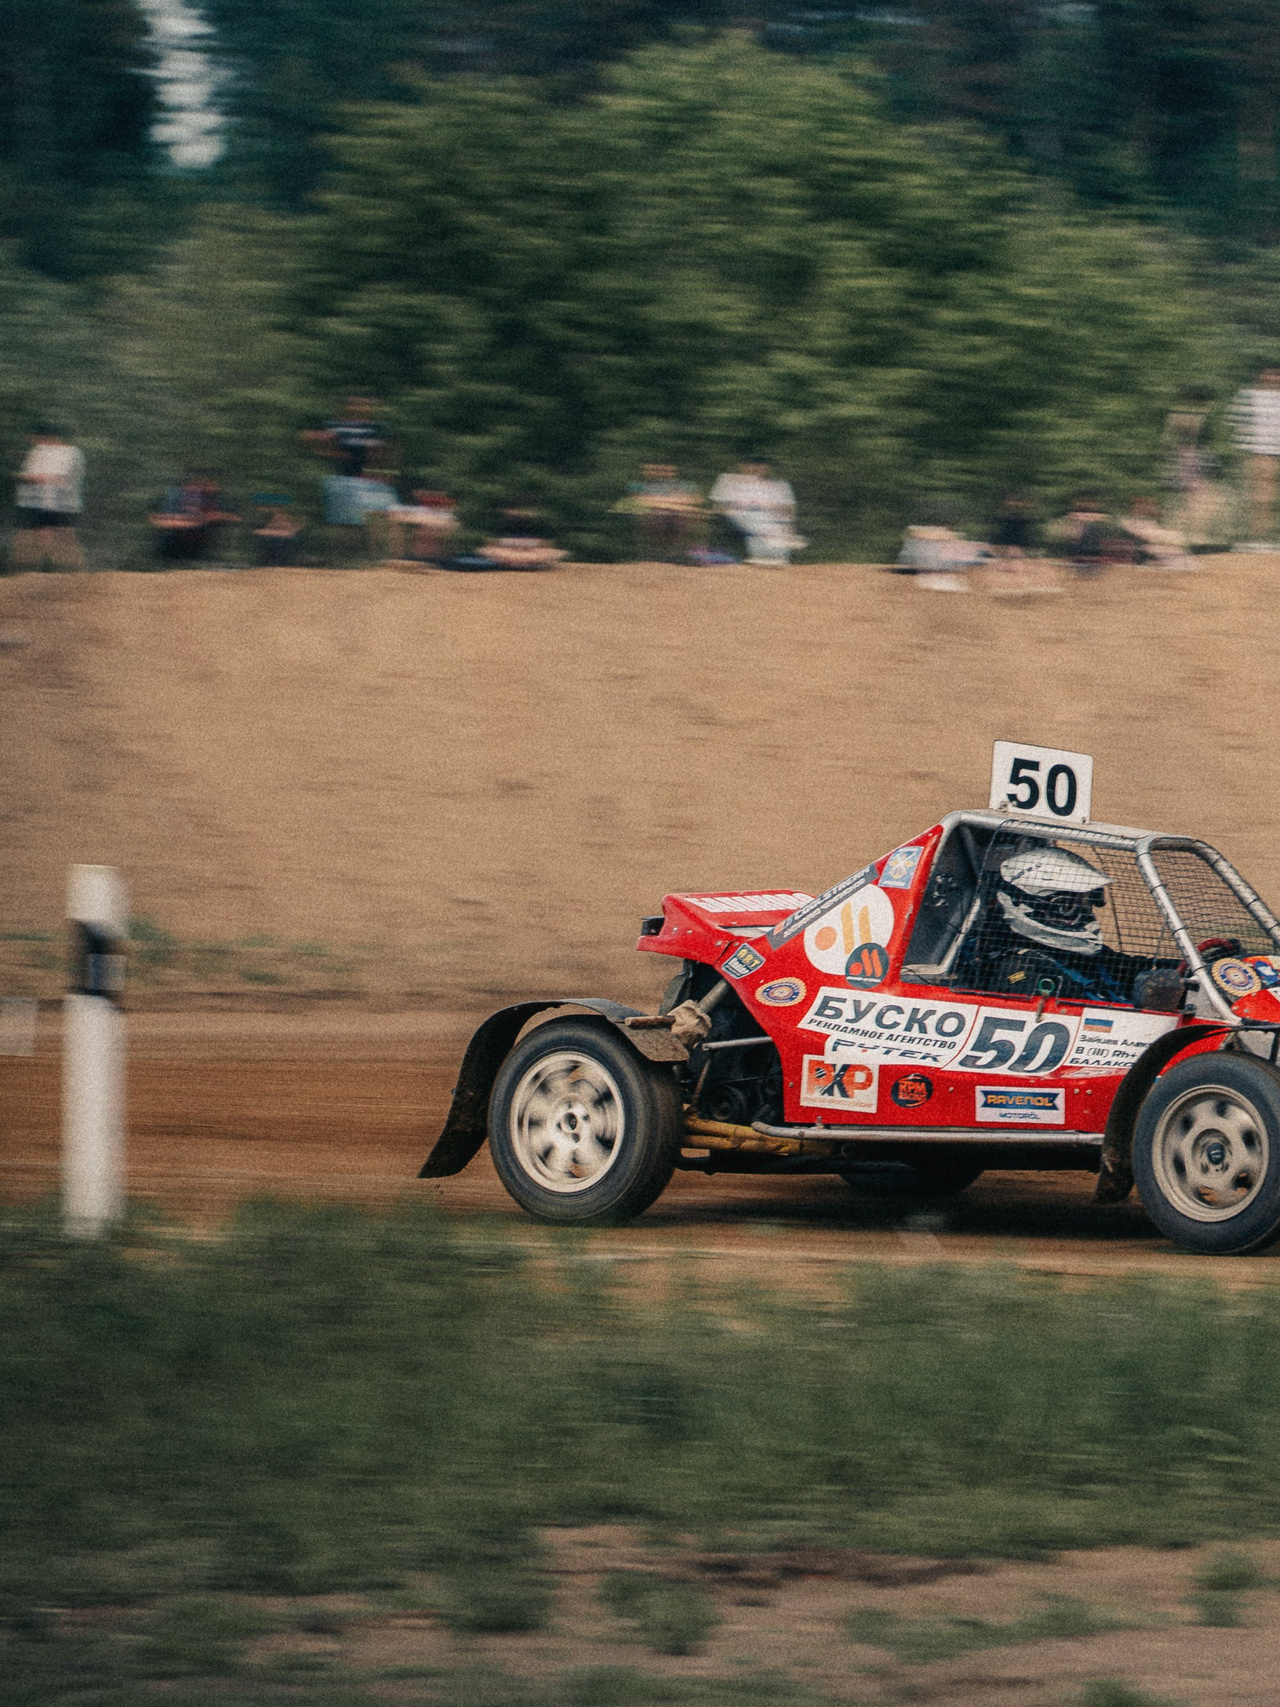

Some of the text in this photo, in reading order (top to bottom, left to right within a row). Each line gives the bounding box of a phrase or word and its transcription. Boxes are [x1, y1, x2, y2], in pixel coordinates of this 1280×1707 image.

[1006, 757, 1078, 817] 50
[807, 1018, 957, 1050] РЕКЛАМНОЕ АГЕНТСТВО
[813, 995, 966, 1038] БУСКО
[958, 1016, 1070, 1073] 50
[1111, 1049, 1138, 1059] Rh+
[986, 1094, 1054, 1107] RAVENOL
